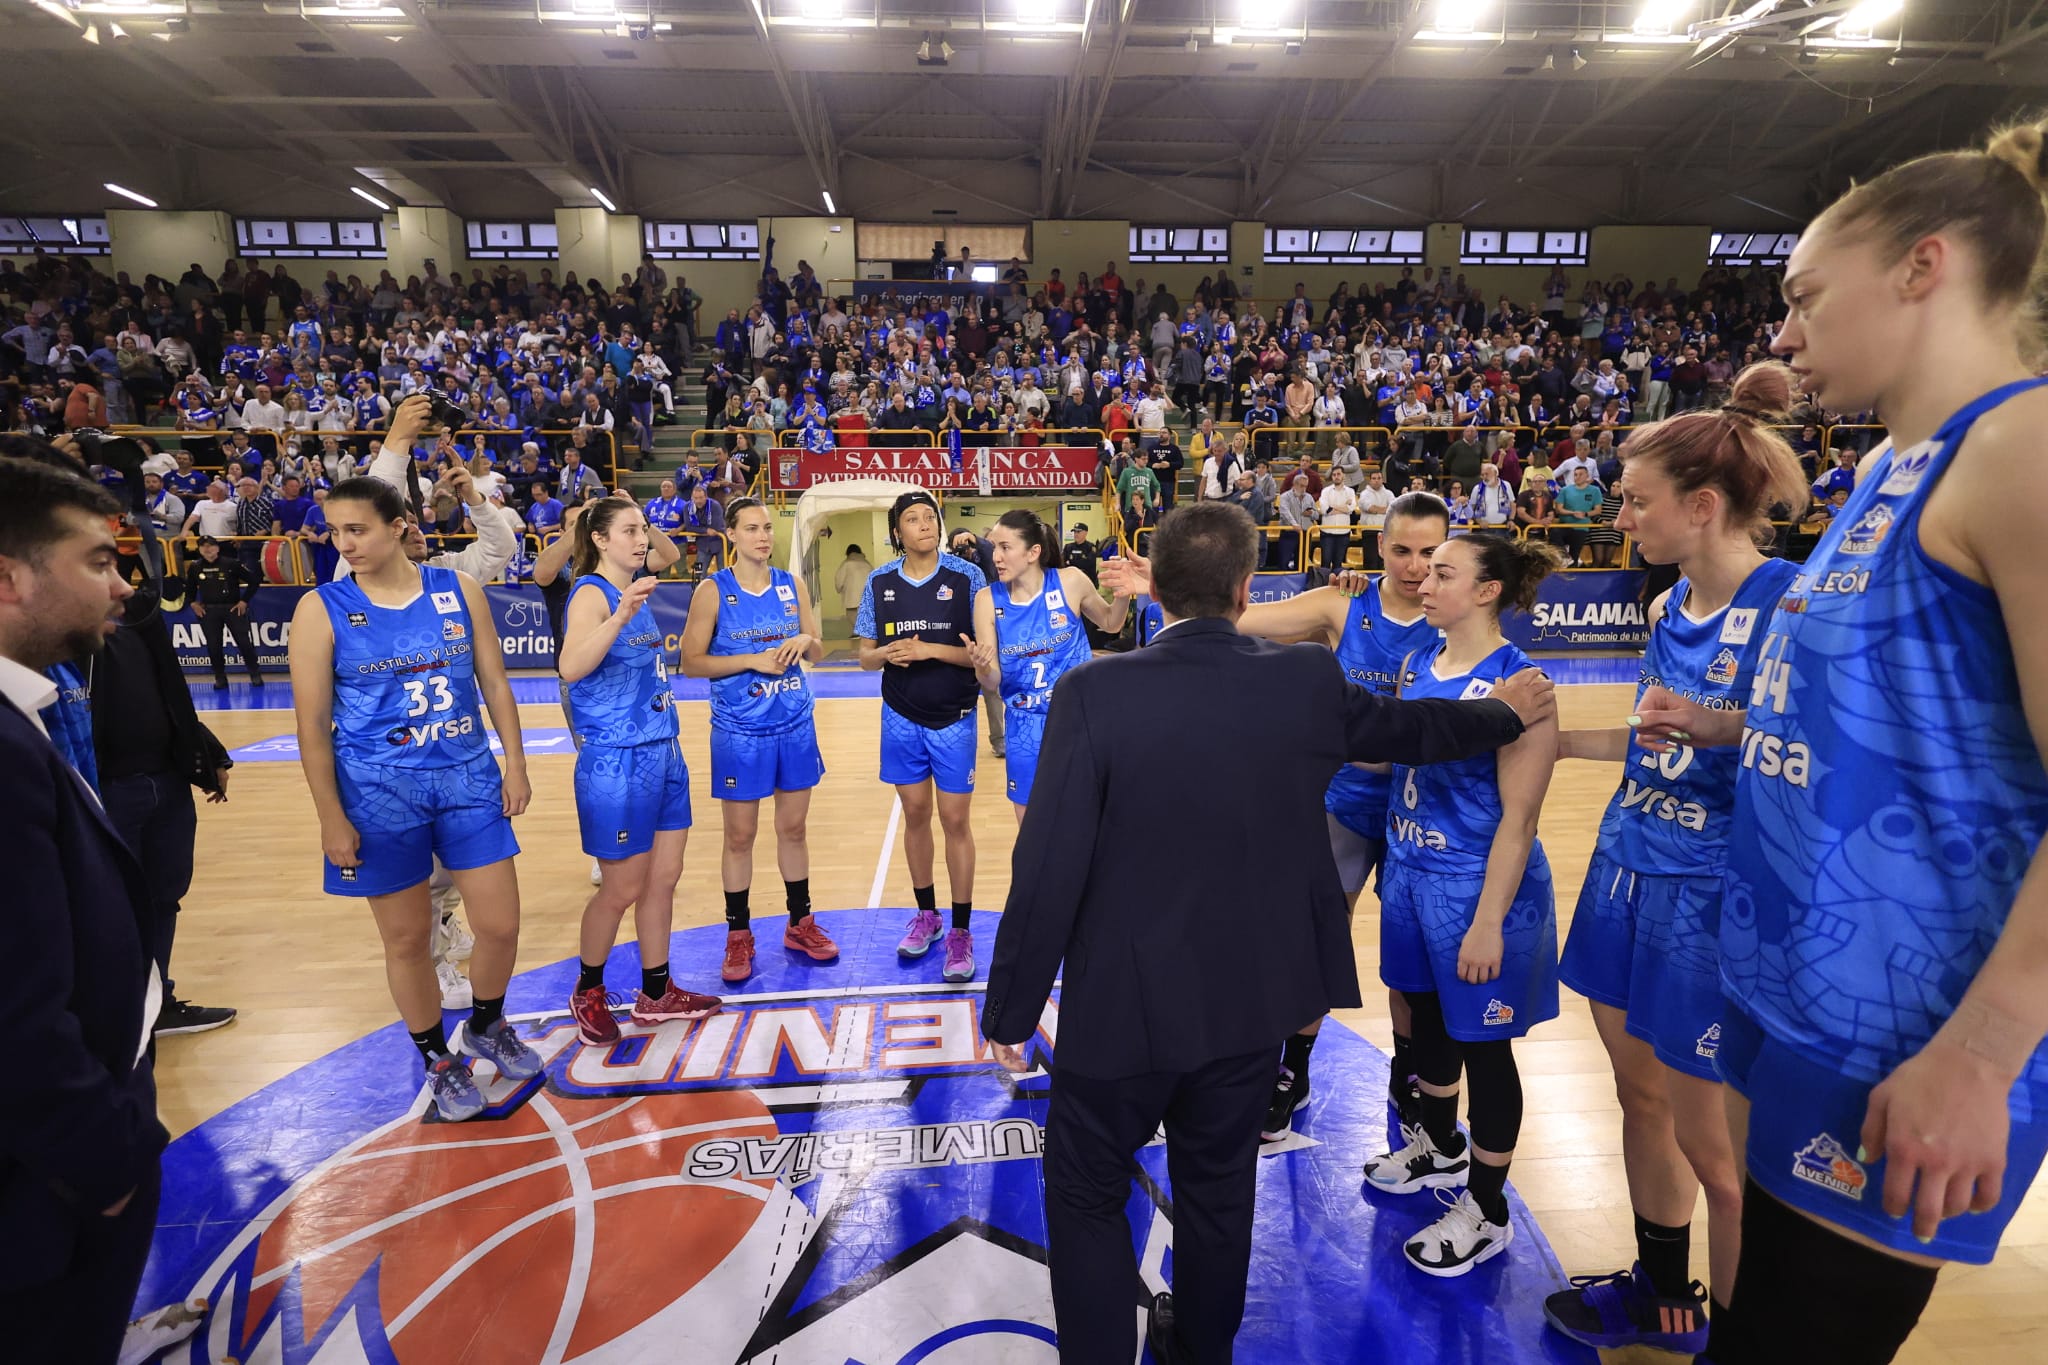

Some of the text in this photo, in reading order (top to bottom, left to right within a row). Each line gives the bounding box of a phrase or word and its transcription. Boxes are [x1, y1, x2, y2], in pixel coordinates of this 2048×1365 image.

[928, 473, 953, 487] DE
[959, 473, 979, 486] LA
[988, 471, 1093, 487] HUMANIDAD
[1811, 566, 1873, 593] LEÓN
[896, 619, 928, 635] pans
[1532, 602, 1645, 627] SALAMA
[1571, 631, 1618, 641] Patrimonio
[1620, 631, 1630, 641] de
[1632, 631, 1640, 641] la
[358, 653, 426, 674] CASTILLA
[431, 649, 441, 659] Y
[445, 641, 471, 657] LEÓN
[656, 653, 668, 683] 4
[1031, 662, 1048, 689] 2
[403, 675, 454, 717] 33
[1403, 767, 1418, 810] 6
[1796, 1163, 1864, 1198] AVENIDA
